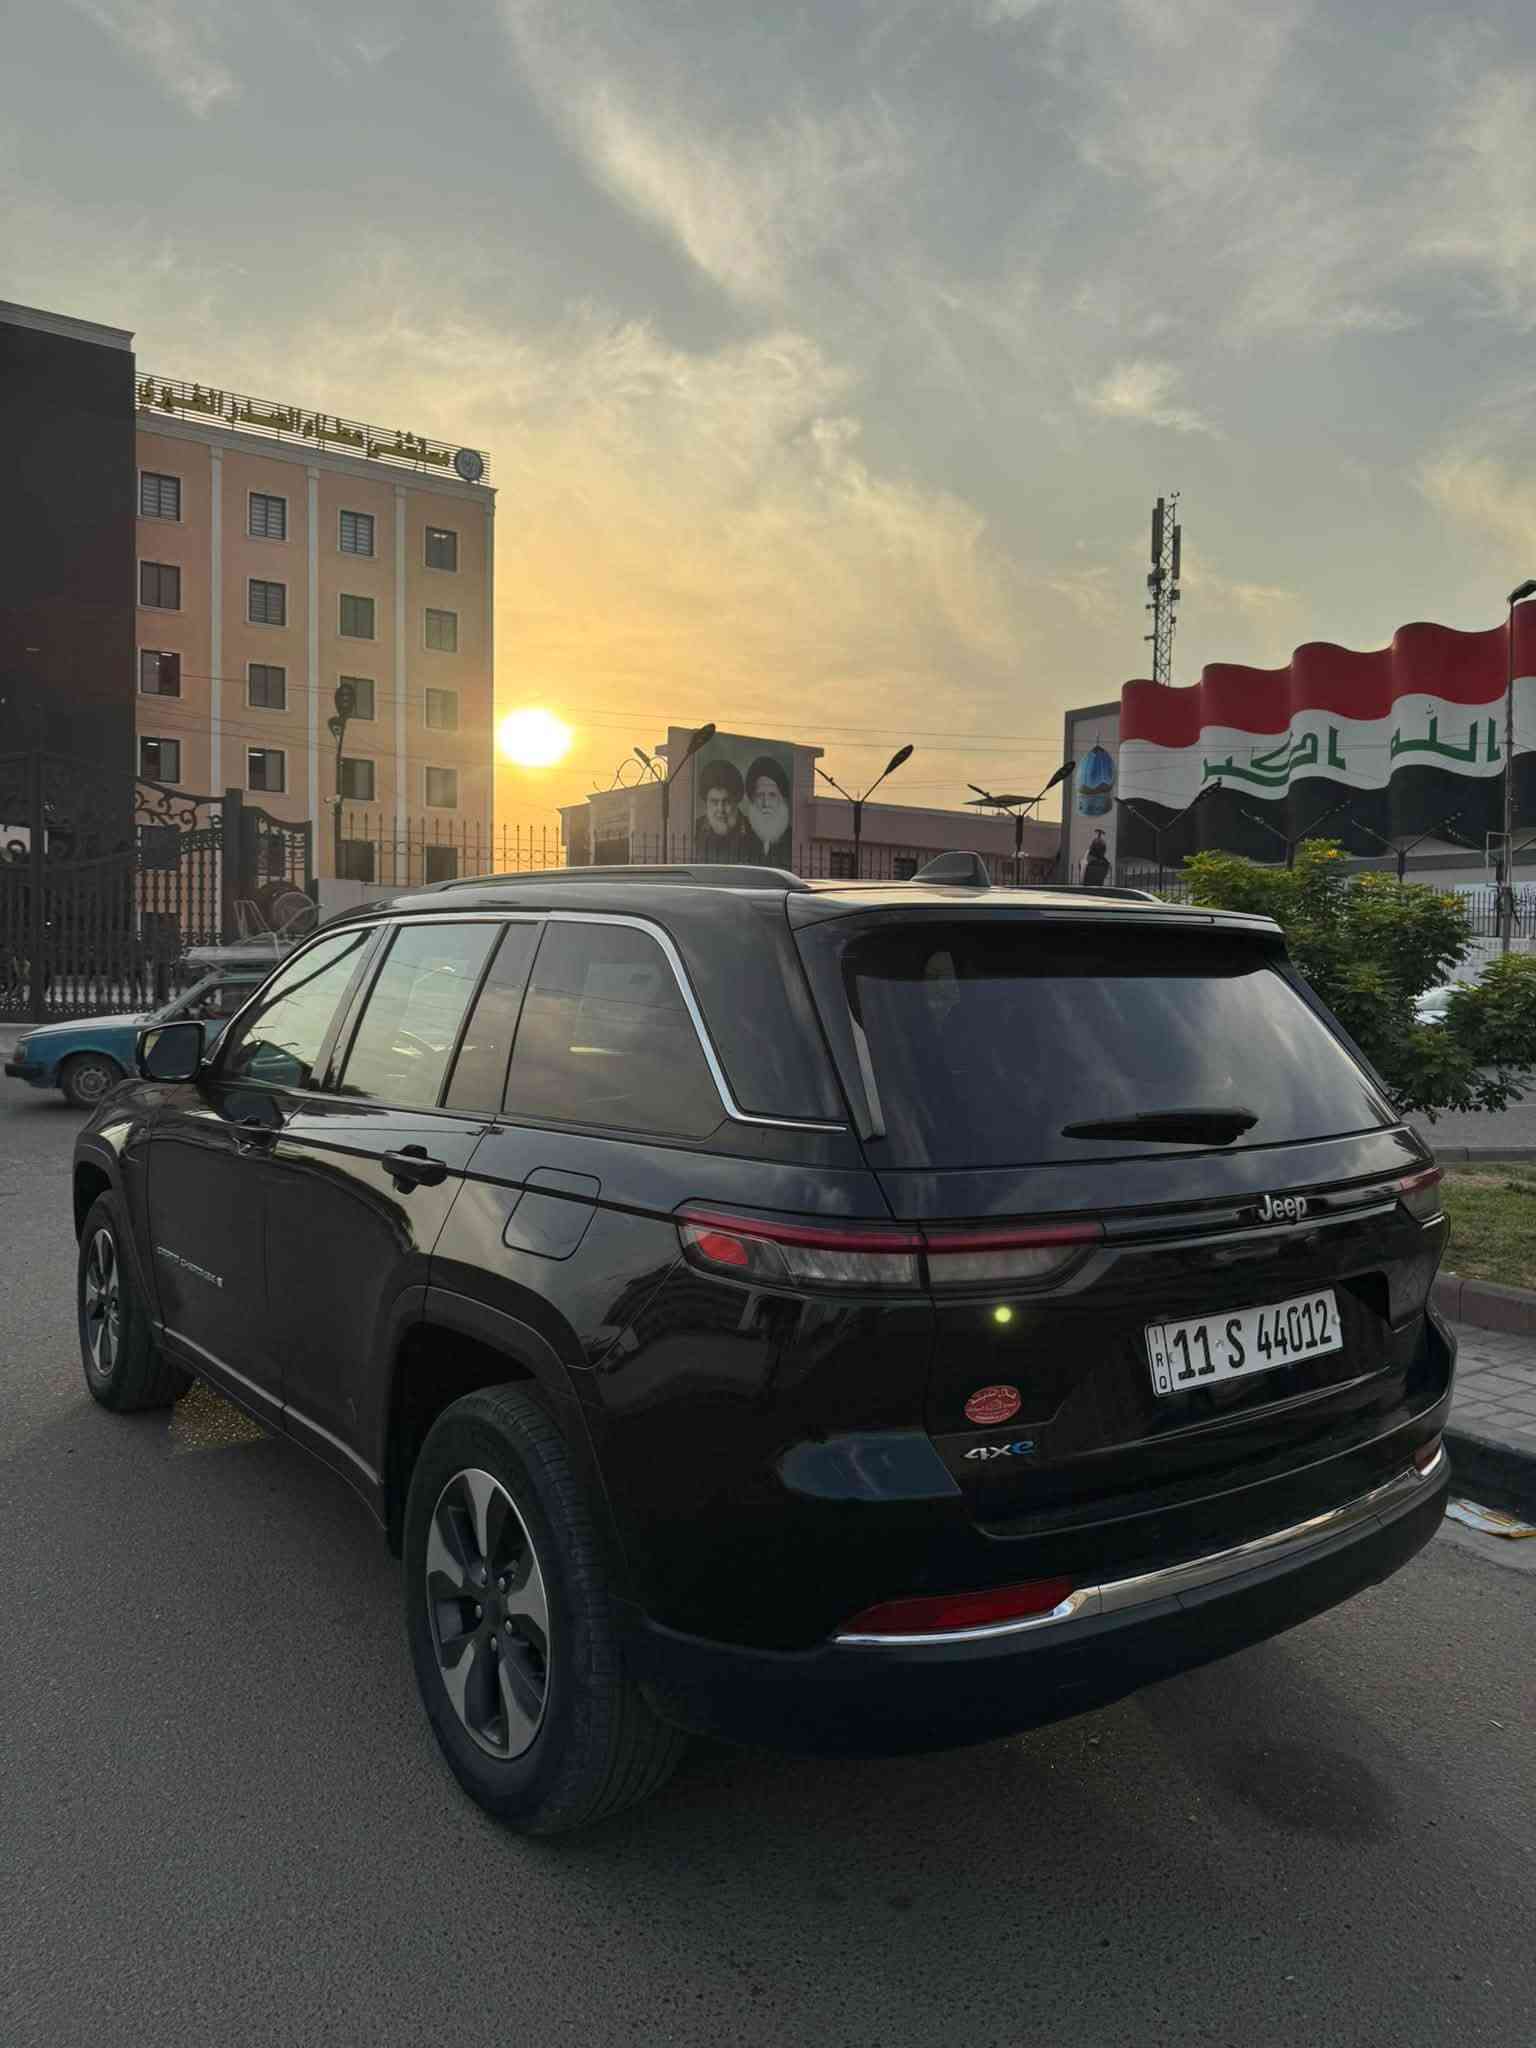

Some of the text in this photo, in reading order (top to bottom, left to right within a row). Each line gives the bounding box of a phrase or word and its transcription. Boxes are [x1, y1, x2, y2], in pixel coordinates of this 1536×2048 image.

[1259, 1194, 1307, 1221] Jeep
[1173, 1299, 1333, 1380] 11 S 44012
